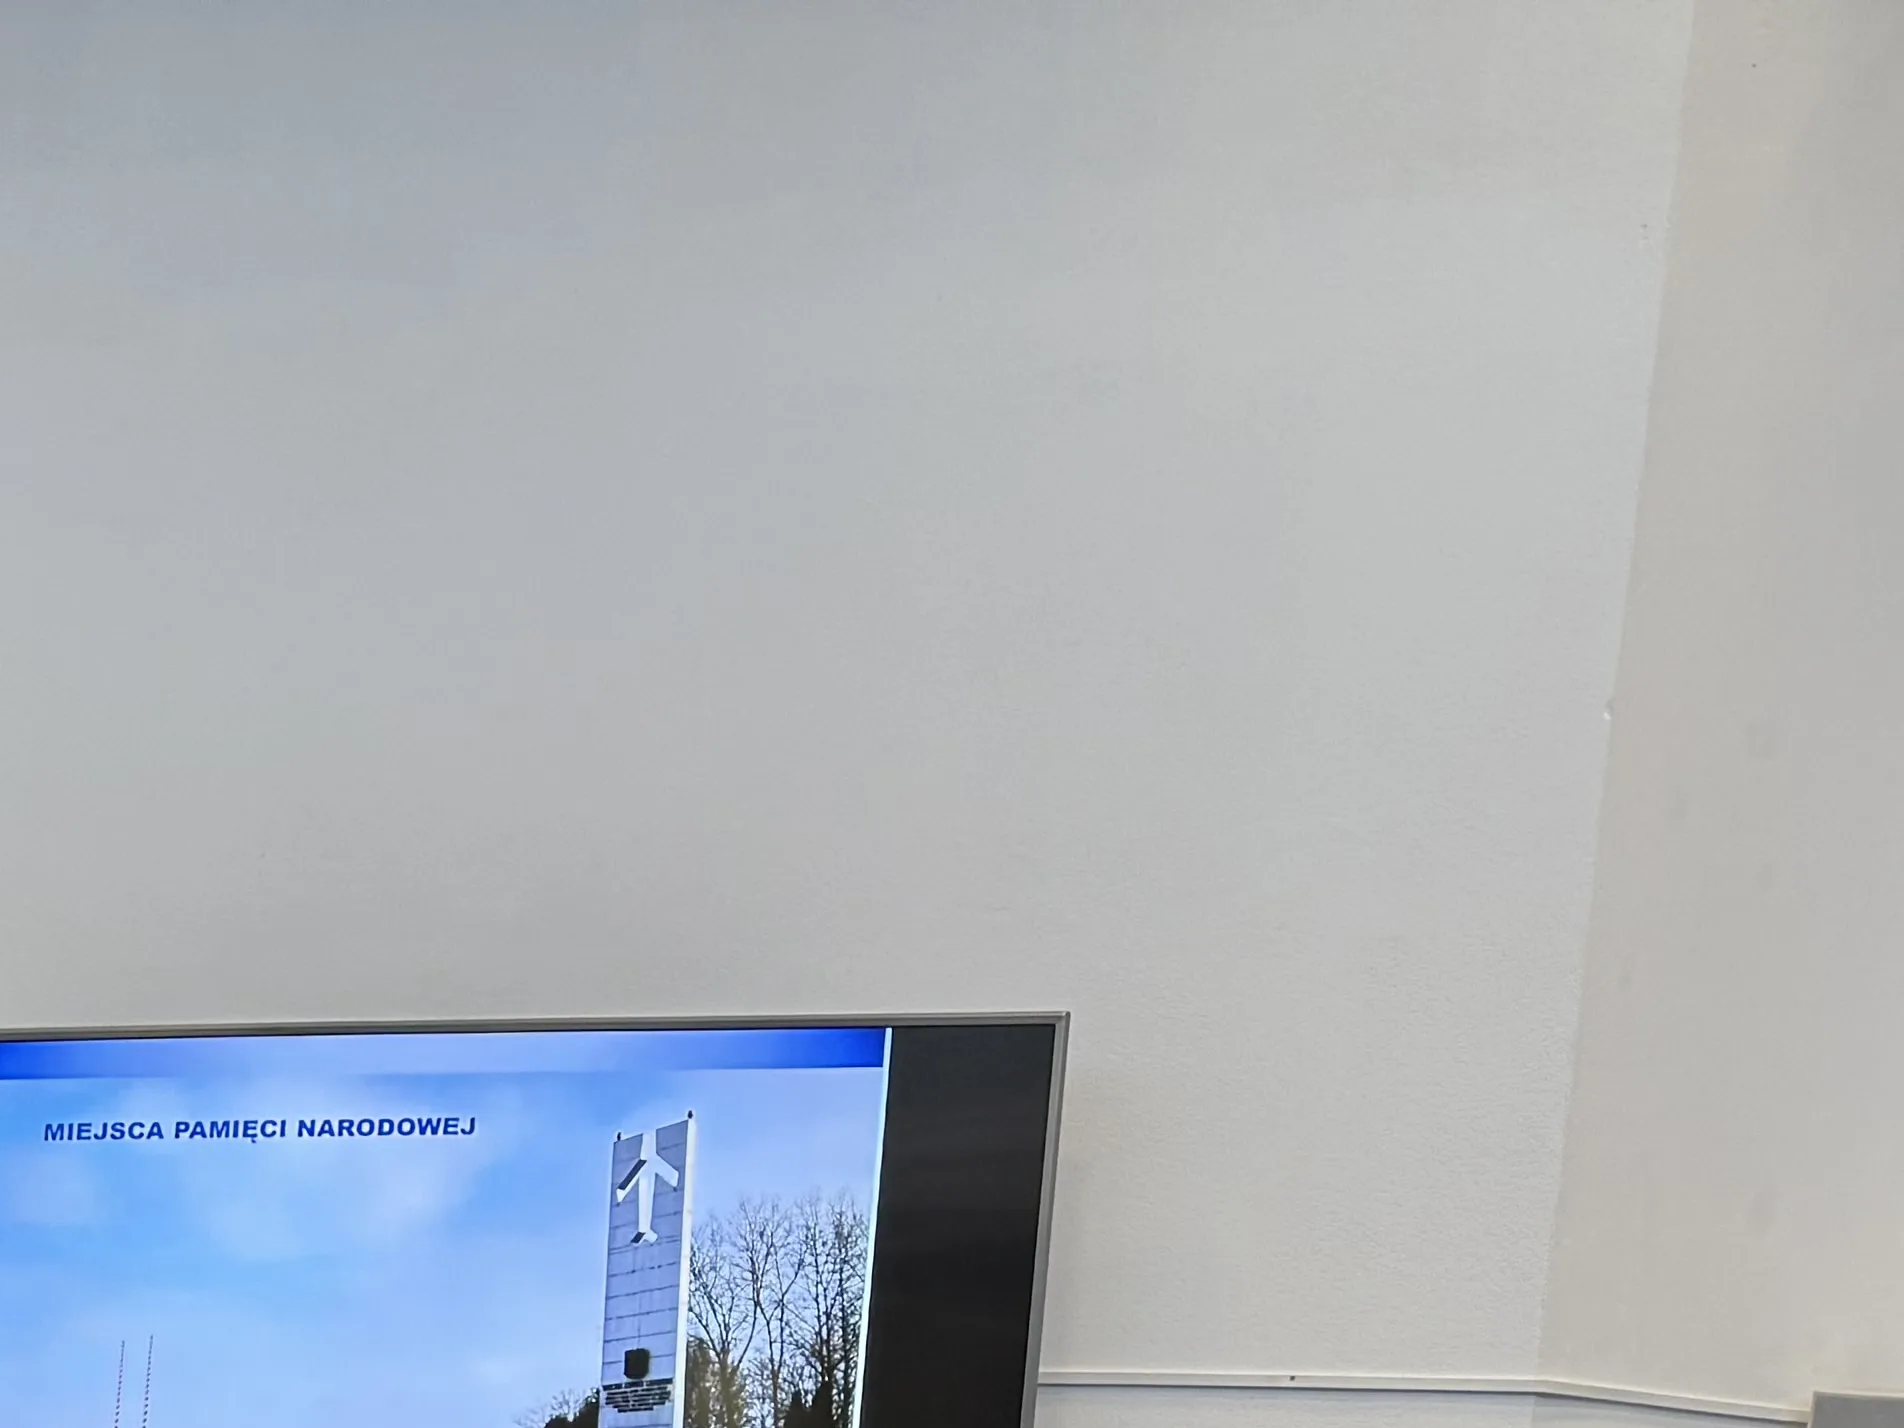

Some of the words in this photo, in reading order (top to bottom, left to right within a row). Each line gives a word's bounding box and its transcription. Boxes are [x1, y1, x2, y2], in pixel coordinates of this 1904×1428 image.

[44, 1121, 165, 1141] MIEJSCA
[174, 1119, 287, 1143] PAMIĘCI
[297, 1116, 477, 1138] NARODOWEJ
